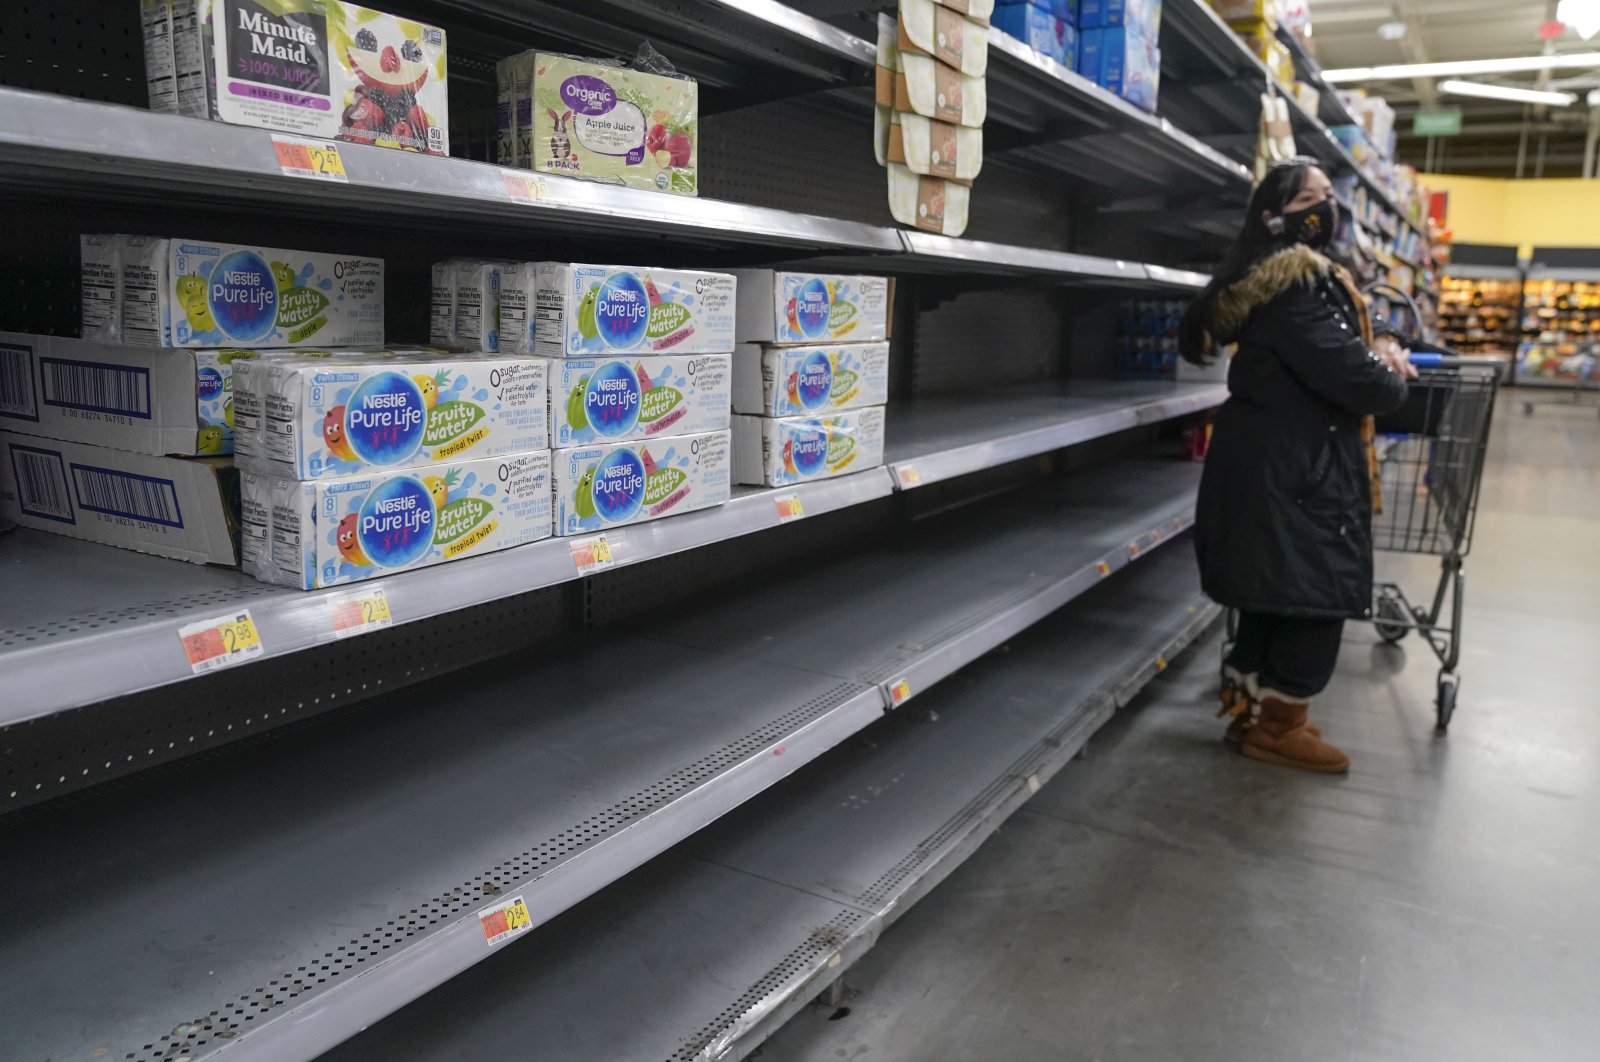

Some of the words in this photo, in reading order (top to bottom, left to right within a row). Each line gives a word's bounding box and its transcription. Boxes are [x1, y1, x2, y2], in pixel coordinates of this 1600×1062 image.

[238, 8, 316, 45] Minute
[250, 32, 309, 65] Maid
[249, 59, 279, 77] 100%
[566, 84, 611, 102] Organic
[430, 128, 441, 139] 90
[585, 118, 611, 131] Apple
[613, 122, 636, 132] Juice
[547, 160, 553, 168] 8
[555, 160, 580, 171] PACK
[179, 257, 185, 271] 8
[334, 261, 344, 279] 0
[576, 278, 581, 290] 8
[212, 284, 249, 303] Pure
[250, 287, 274, 310] Life
[281, 292, 320, 313] fruity
[279, 306, 314, 324] water
[599, 301, 626, 317] Pure
[627, 303, 646, 323] Life
[651, 303, 684, 322] fruity
[799, 301, 816, 313] Pure
[816, 300, 828, 317] Life
[300, 322, 318, 339] apple
[650, 317, 679, 333] water
[490, 369, 501, 388] 0
[500, 364, 521, 377] sugar
[688, 360, 696, 376] 0
[564, 372, 569, 383] 8
[800, 374, 817, 387] Pure
[818, 373, 830, 389] Life
[313, 387, 320, 401] 8
[588, 391, 616, 407] Pure
[618, 391, 637, 410] Life
[642, 389, 676, 408] fruity
[428, 403, 475, 429] fruity
[641, 400, 670, 418] water
[286, 424, 293, 433] 0
[350, 409, 393, 429] Pure
[394, 407, 422, 432] Life
[426, 419, 467, 442] water
[439, 438, 466, 458] tropical
[466, 430, 484, 449] twist
[691, 439, 699, 455] 0
[794, 442, 814, 455] Pure
[814, 440, 826, 457] Life
[498, 463, 508, 482] 0
[508, 457, 528, 471] sugar
[572, 463, 577, 473] 8
[513, 476, 532, 486] purified
[595, 479, 622, 494] Pure
[623, 475, 642, 494] Life
[646, 470, 680, 490] fruity
[645, 481, 675, 500] water
[326, 498, 334, 511] 8
[363, 514, 403, 535] Pure
[404, 508, 431, 533] Life
[437, 501, 483, 528] fruity
[436, 516, 476, 541] water
[450, 535, 476, 555] tropical
[476, 524, 493, 544] twist
